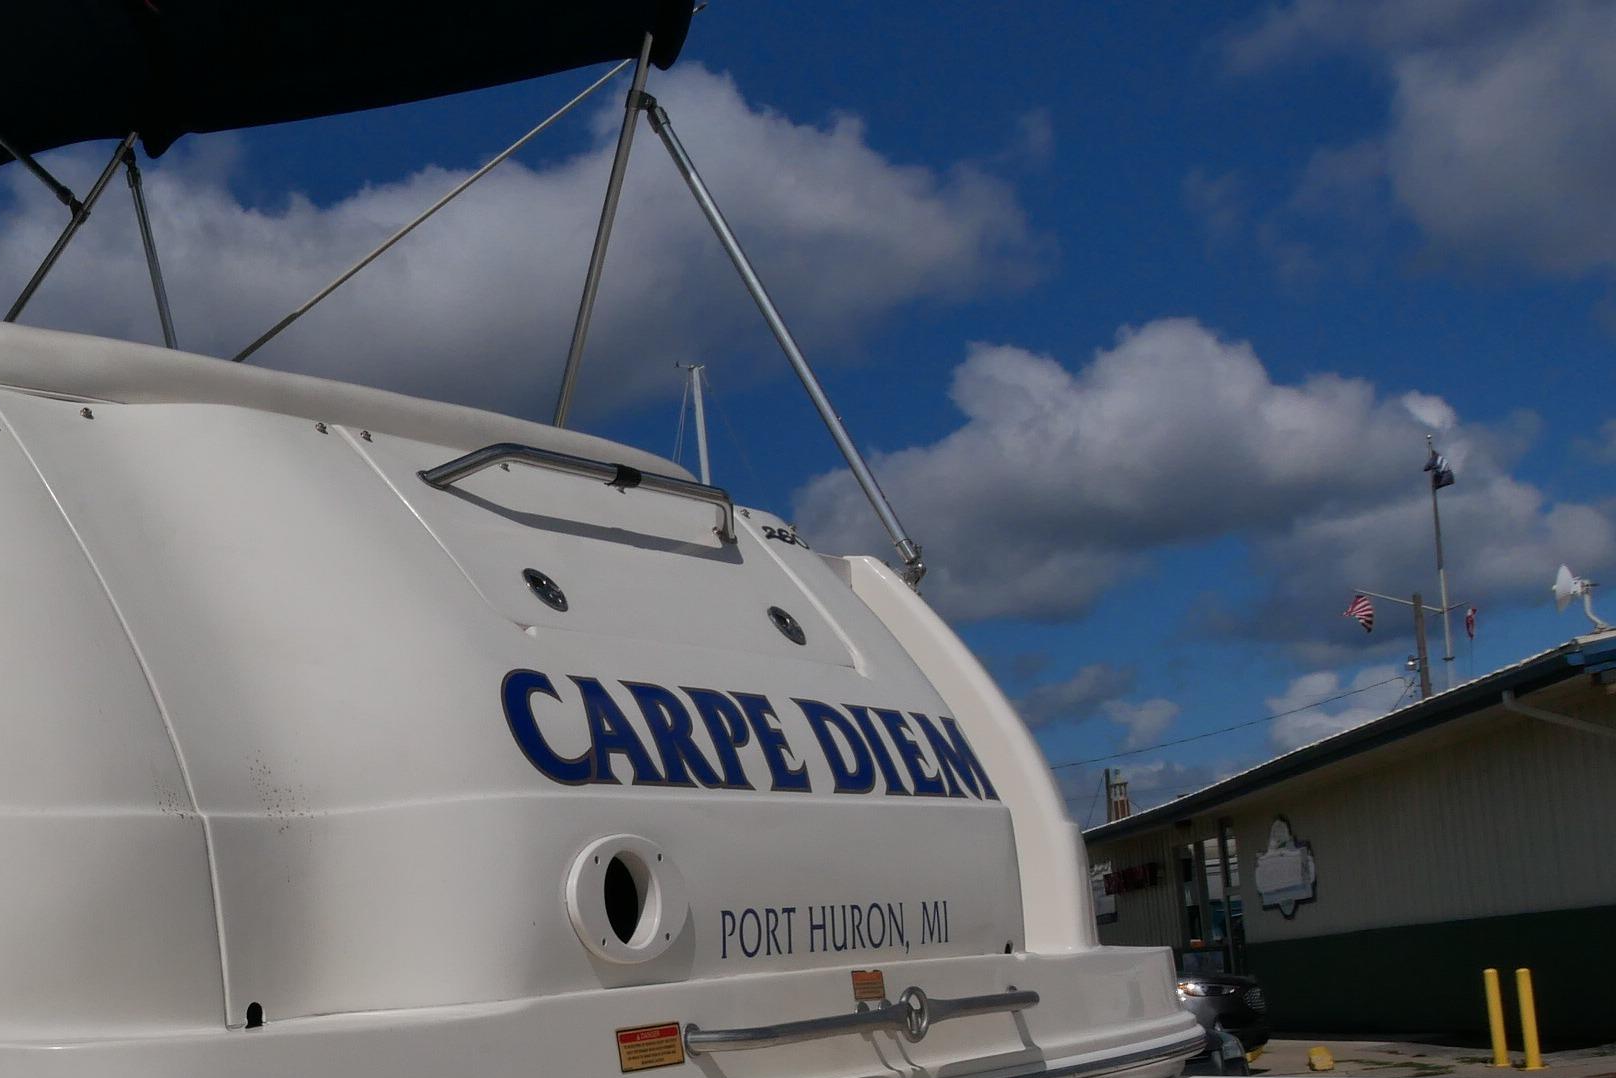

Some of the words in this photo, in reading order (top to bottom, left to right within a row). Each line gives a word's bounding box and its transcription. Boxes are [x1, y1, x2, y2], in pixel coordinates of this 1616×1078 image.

[500, 668, 812, 793] CARPE
[790, 697, 1002, 801] DIEM
[720, 907, 796, 959] PORT
[809, 902, 911, 954] HURON,
[921, 900, 951, 945] MI
